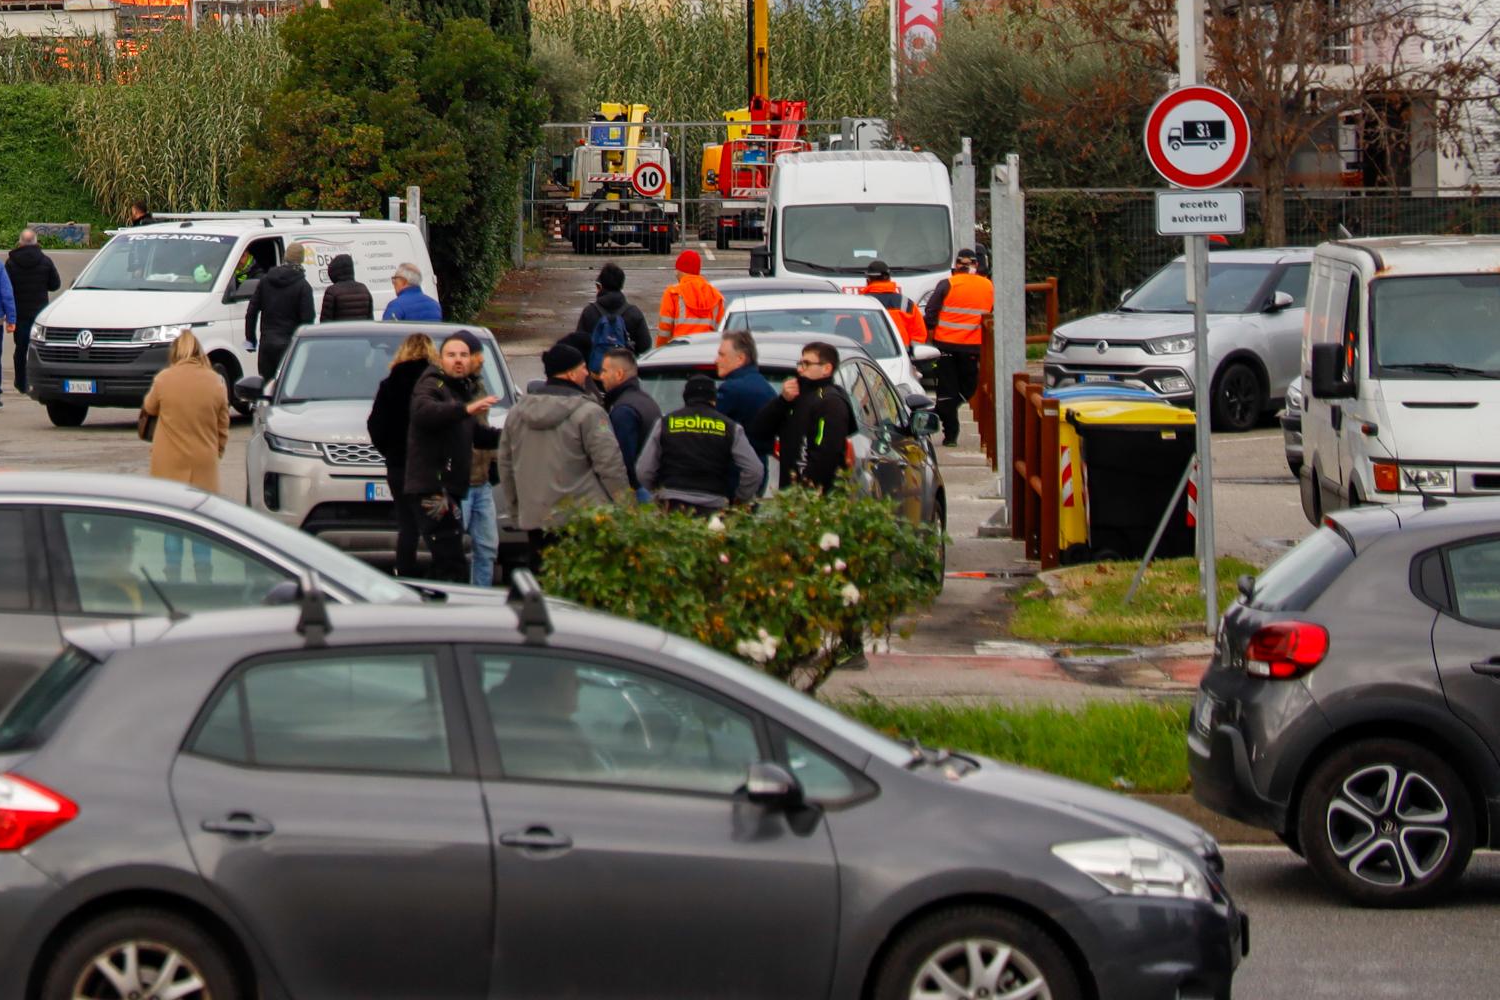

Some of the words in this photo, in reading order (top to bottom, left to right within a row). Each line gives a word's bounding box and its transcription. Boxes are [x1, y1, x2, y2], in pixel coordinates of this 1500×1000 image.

[641, 171, 659, 187] 10
[1180, 200, 1219, 209] eccetto
[1171, 213, 1227, 223] autorizzati
